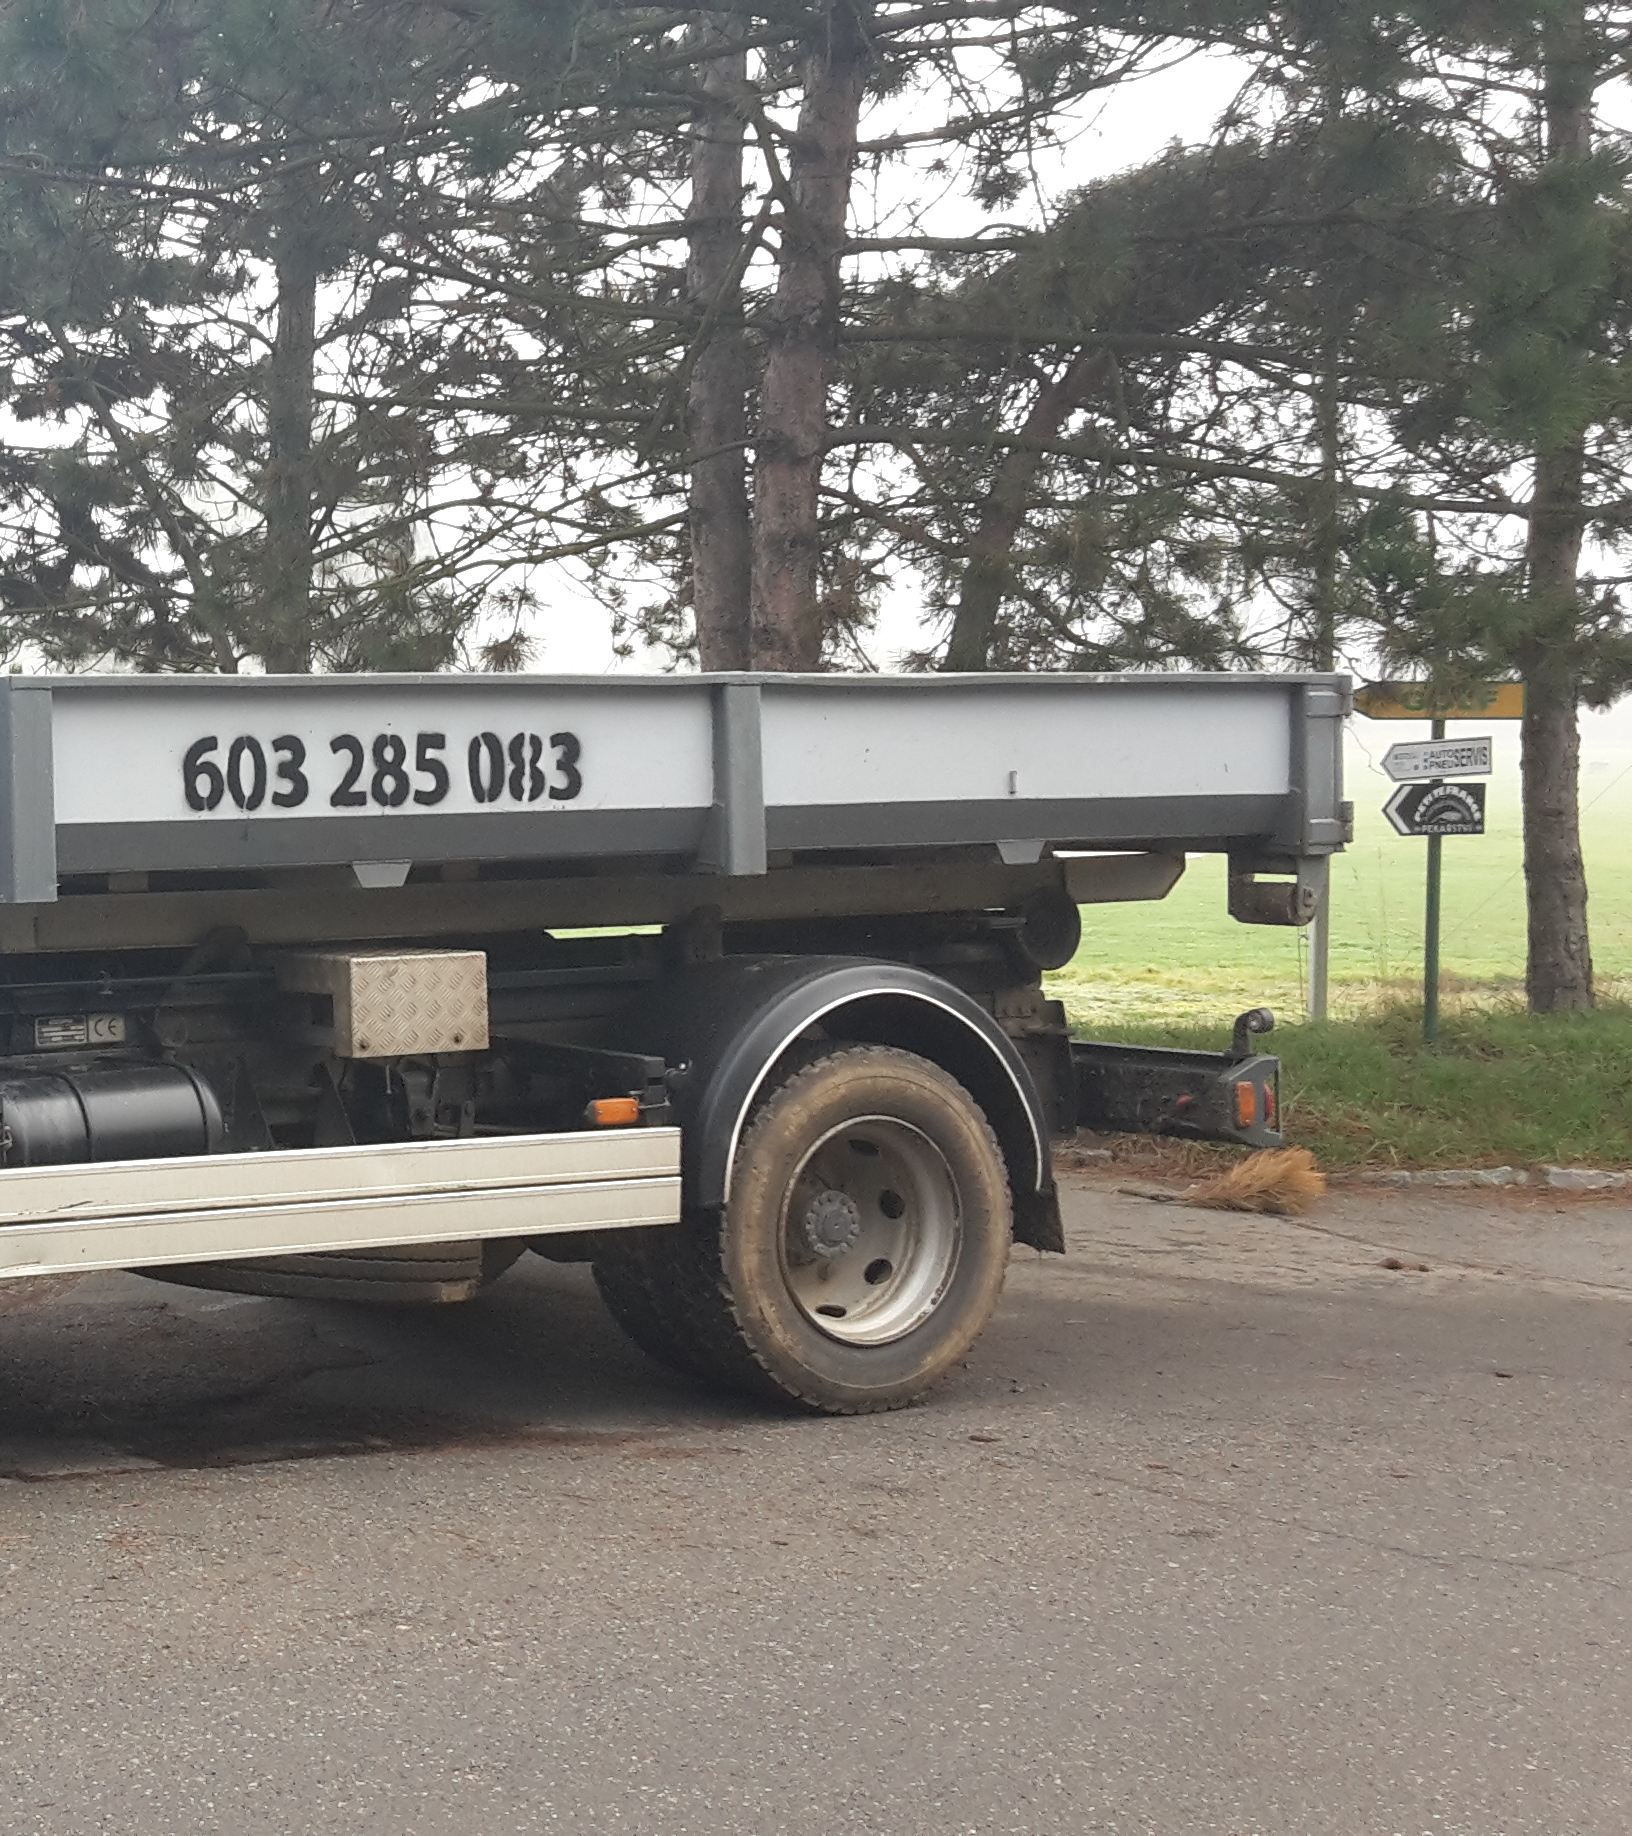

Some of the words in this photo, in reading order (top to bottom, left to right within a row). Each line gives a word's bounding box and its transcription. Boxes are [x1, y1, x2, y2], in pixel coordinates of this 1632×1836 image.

[182, 734, 310, 812] 603
[329, 732, 450, 808] 285
[468, 731, 584, 804] 083
